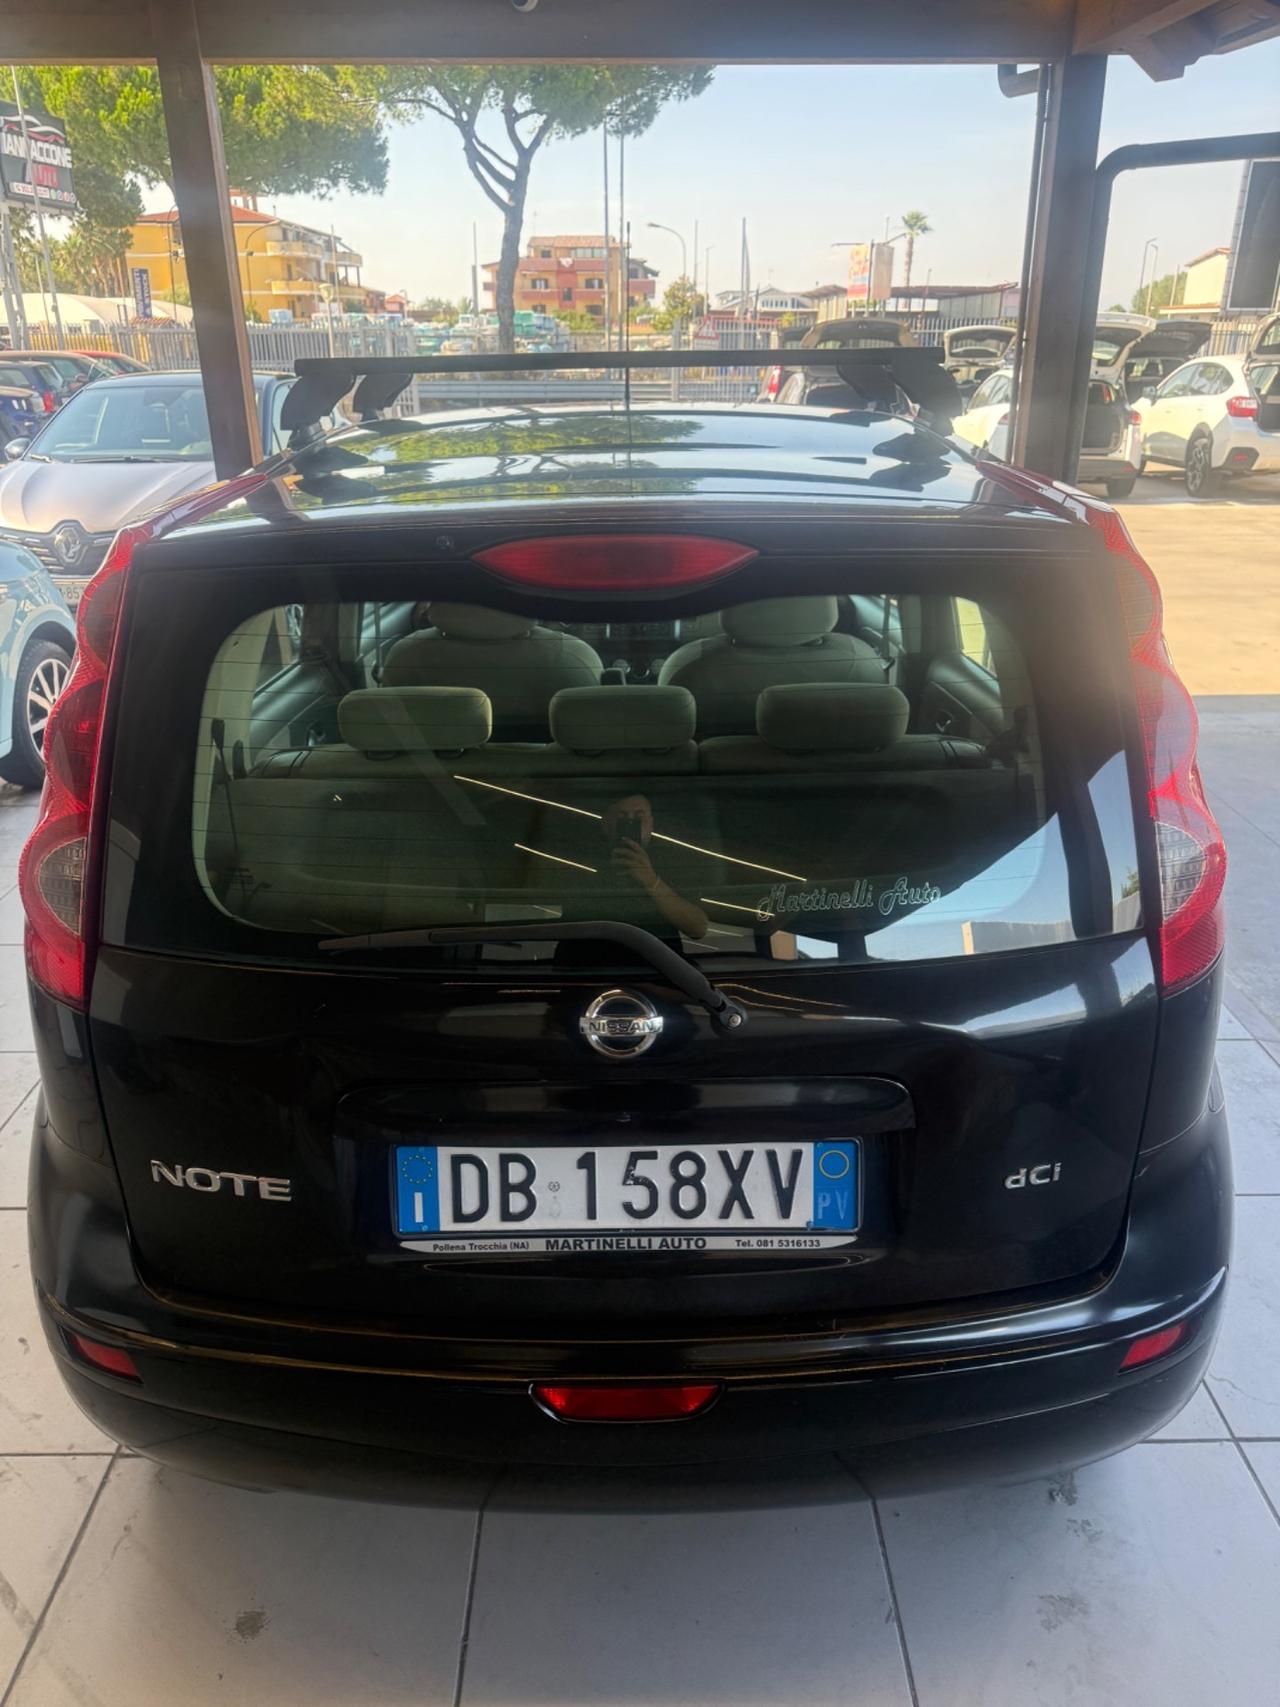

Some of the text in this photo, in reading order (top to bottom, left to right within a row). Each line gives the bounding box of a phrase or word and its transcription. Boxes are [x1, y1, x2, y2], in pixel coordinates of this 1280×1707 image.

[757, 876, 941, 922] Martinelli Auto
[588, 1021, 655, 1034] NISSAN
[151, 1159, 292, 1202] NOTE
[451, 1153, 538, 1223] DB
[1004, 1162, 1062, 1190] dCi
[415, 1192, 424, 1223] I
[817, 1190, 849, 1220] PV
[433, 1237, 821, 1252] Pollena Trocchia (NA) MARTINELLI AUTO Tel. 081 5316133
